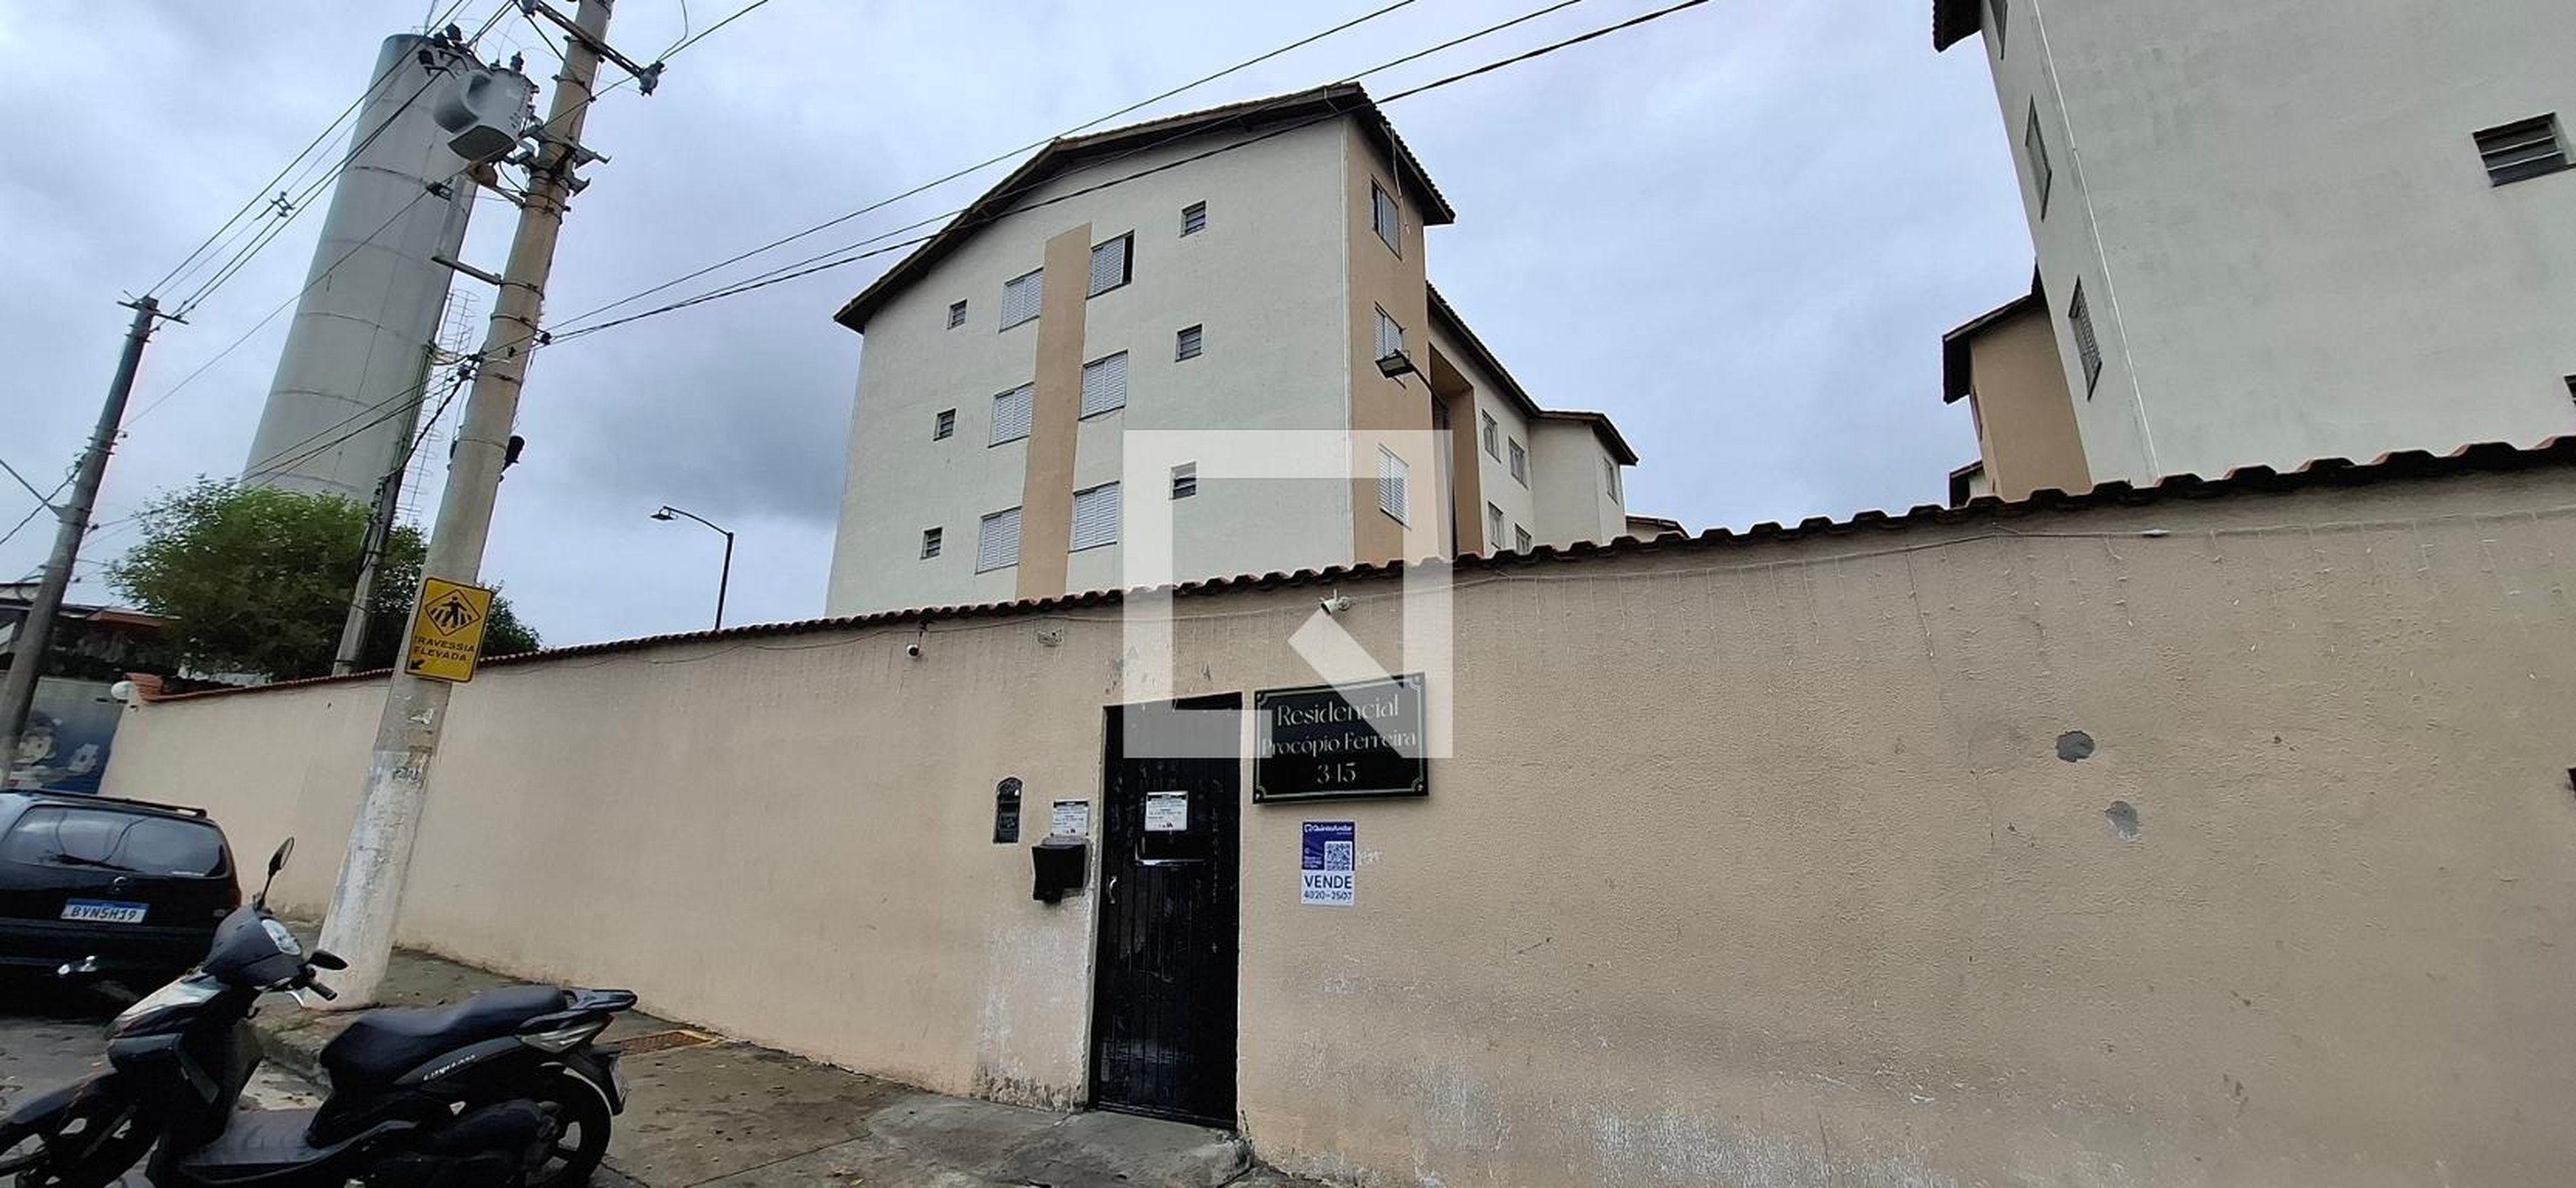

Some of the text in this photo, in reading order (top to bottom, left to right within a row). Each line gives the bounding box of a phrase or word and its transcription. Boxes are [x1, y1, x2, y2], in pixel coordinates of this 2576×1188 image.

[1277, 694, 1399, 726] Residencial
[1262, 729, 1417, 757] Procópio Ferreira
[1317, 762, 1356, 784] 315
[1304, 874, 1352, 889] VENDE
